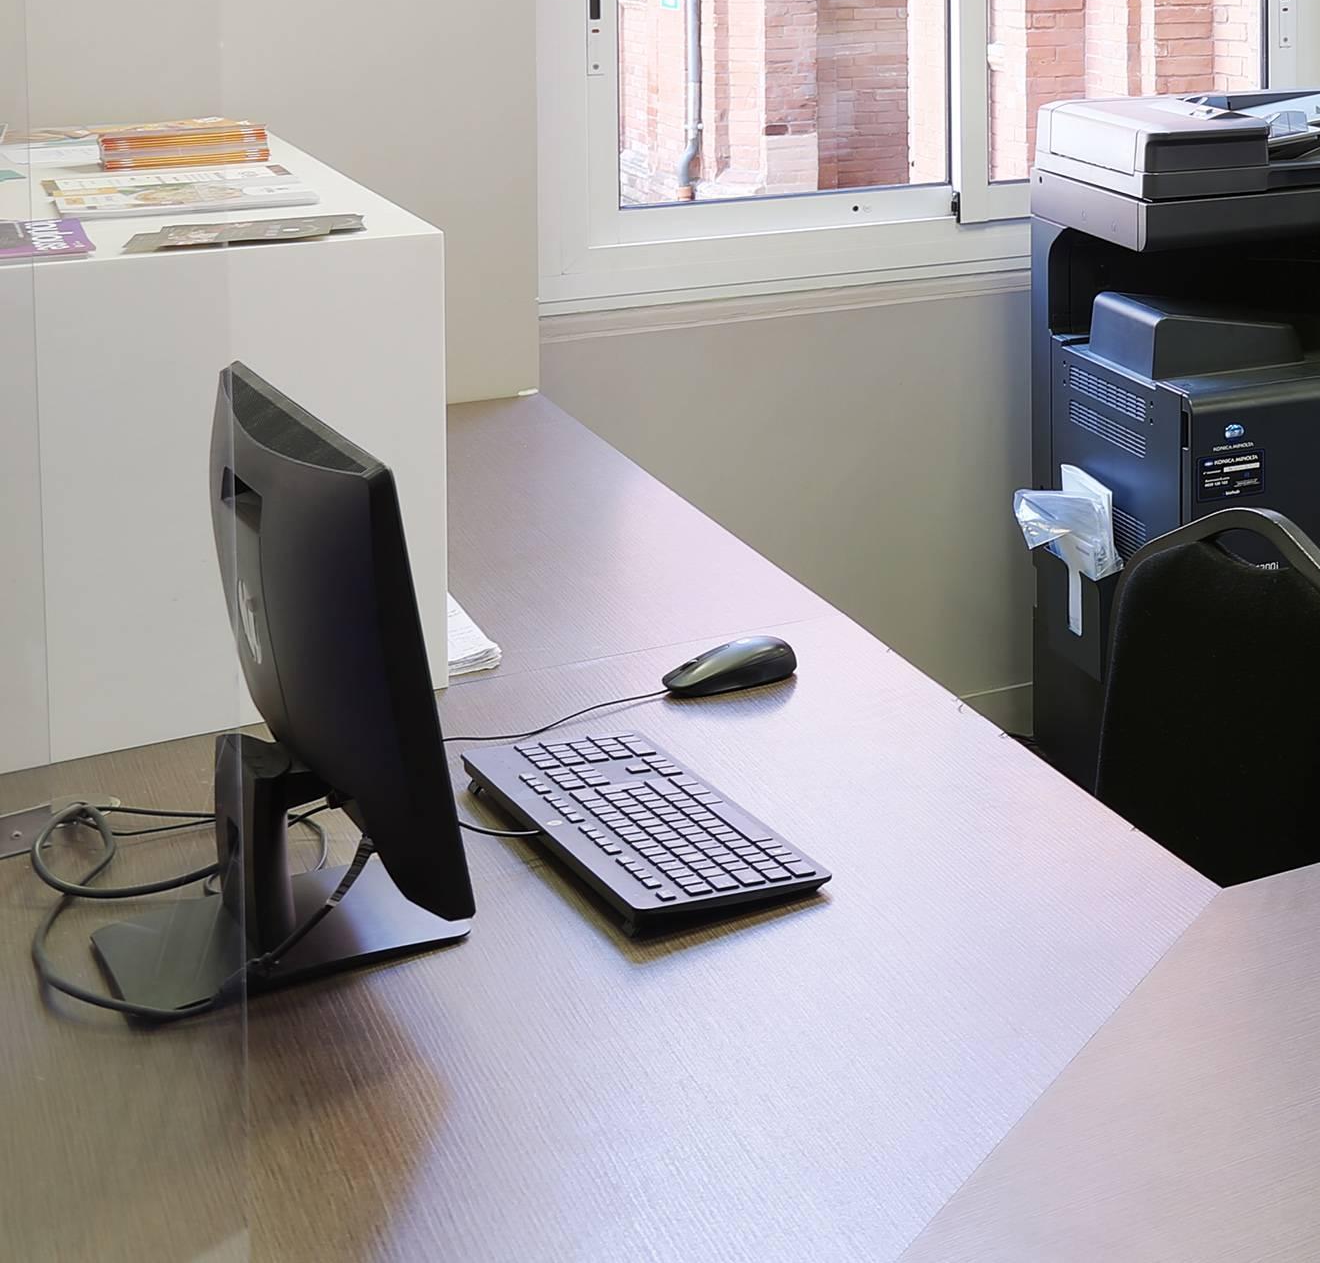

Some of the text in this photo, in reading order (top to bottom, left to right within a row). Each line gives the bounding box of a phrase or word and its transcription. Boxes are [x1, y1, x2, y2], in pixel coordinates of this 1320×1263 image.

[1213, 441, 1255, 453] KONICA MINOLTA
[1214, 454, 1259, 466] KONICA MINOLTA
